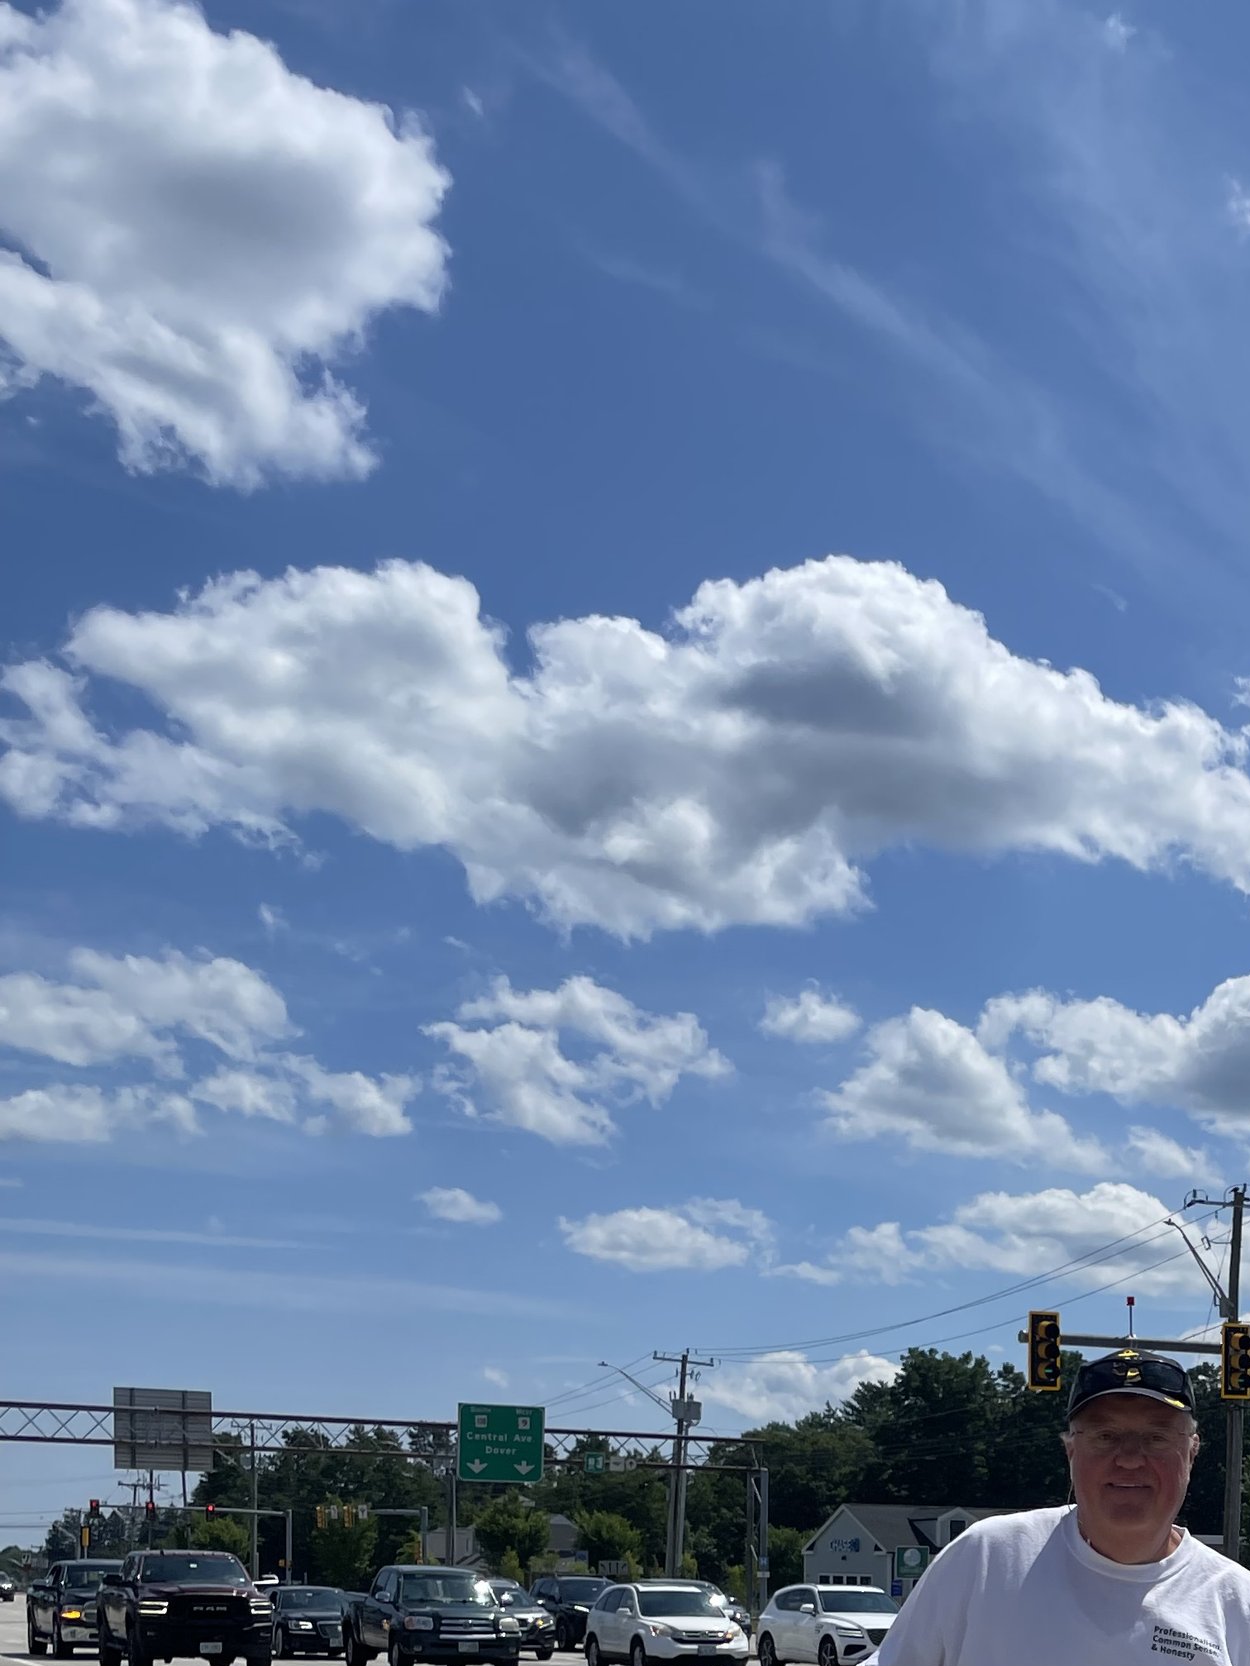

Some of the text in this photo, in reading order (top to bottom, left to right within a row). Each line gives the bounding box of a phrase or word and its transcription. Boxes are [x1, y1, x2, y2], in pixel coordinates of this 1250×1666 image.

[466, 1432, 508, 1442] Central
[485, 1446, 517, 1455] Dover
[1152, 1635, 1191, 1650] Common
[1151, 1643, 1196, 1661] & Honesty
